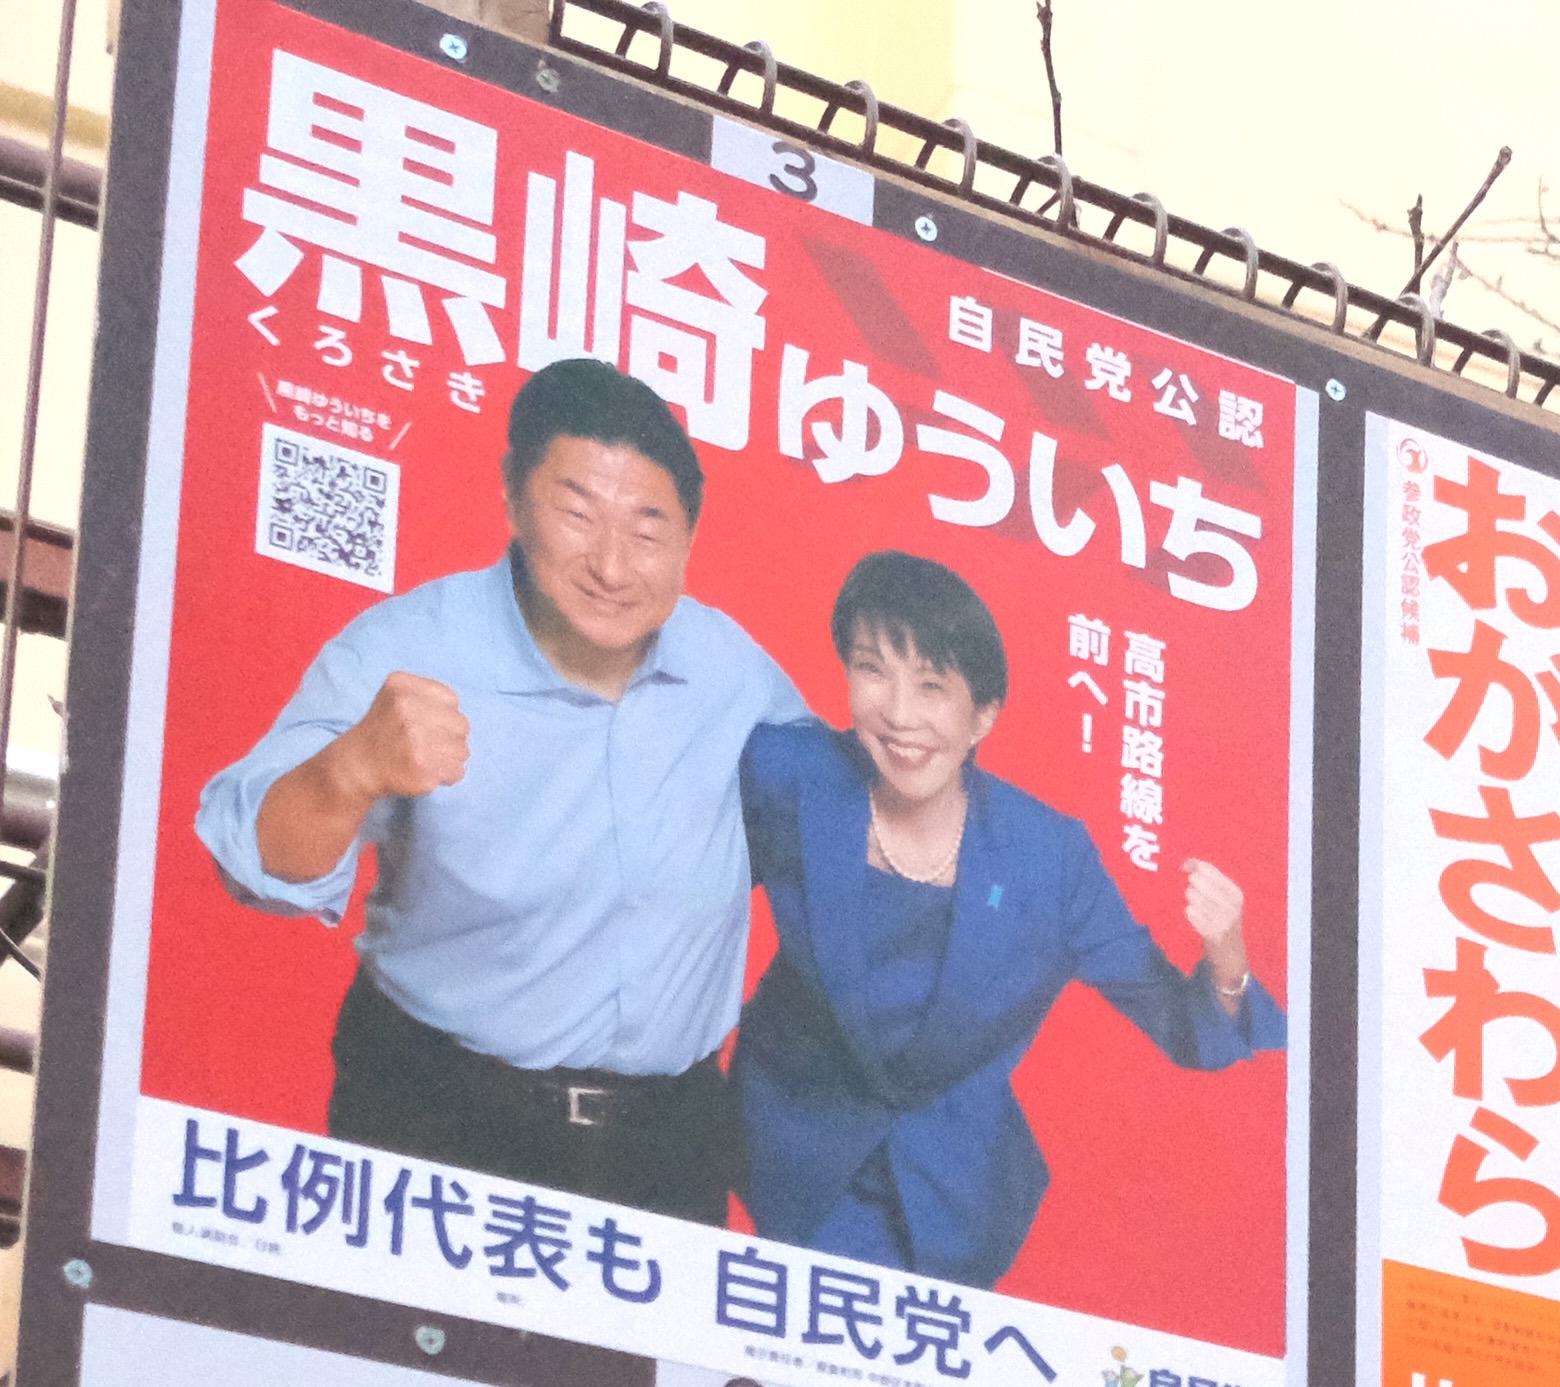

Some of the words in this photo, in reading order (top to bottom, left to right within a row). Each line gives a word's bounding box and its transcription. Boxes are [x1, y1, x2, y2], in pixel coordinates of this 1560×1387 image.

[767, 138, 818, 200] 3
[248, 306, 486, 413] くろさき
[948, 295, 1266, 449] 自民党公認
[1120, 629, 1168, 872] 高市路線を
[173, 1119, 663, 1305] 比例代表も
[714, 1247, 1060, 1384] 自民党へ
